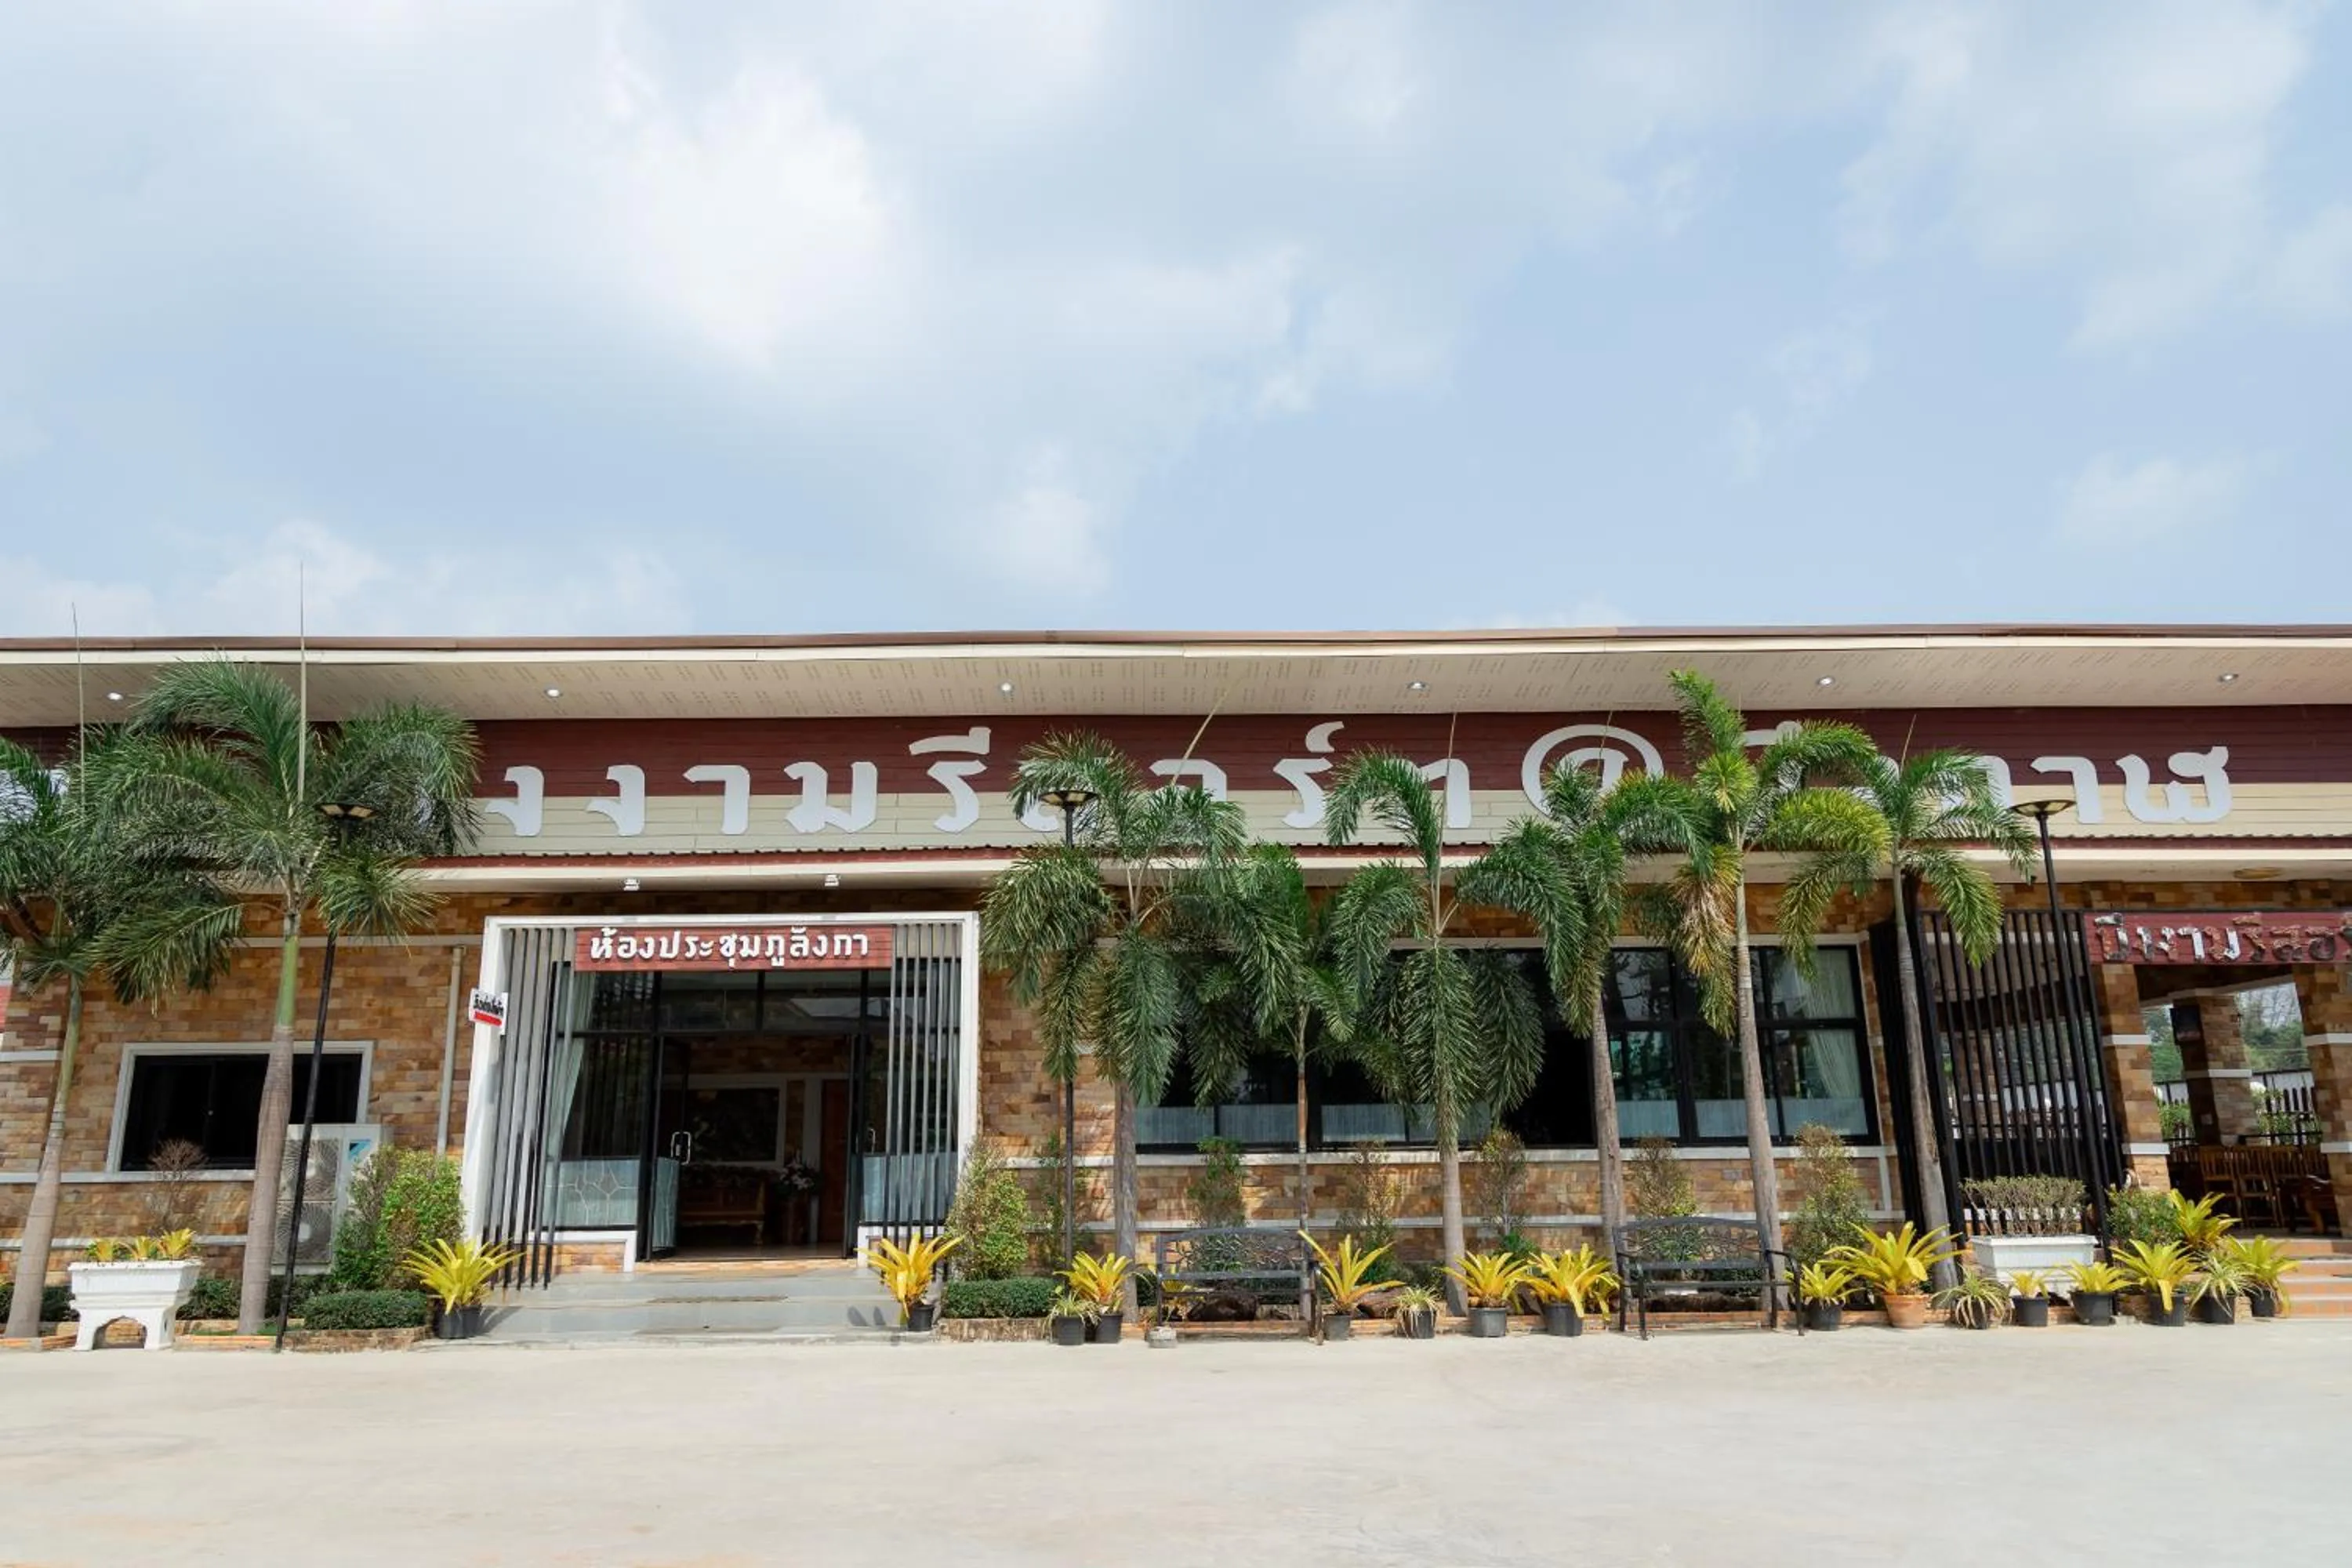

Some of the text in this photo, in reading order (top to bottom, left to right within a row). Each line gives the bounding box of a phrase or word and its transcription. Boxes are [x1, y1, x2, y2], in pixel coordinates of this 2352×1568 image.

[590, 926, 868, 967] ห้องประชุมภูลังกา
